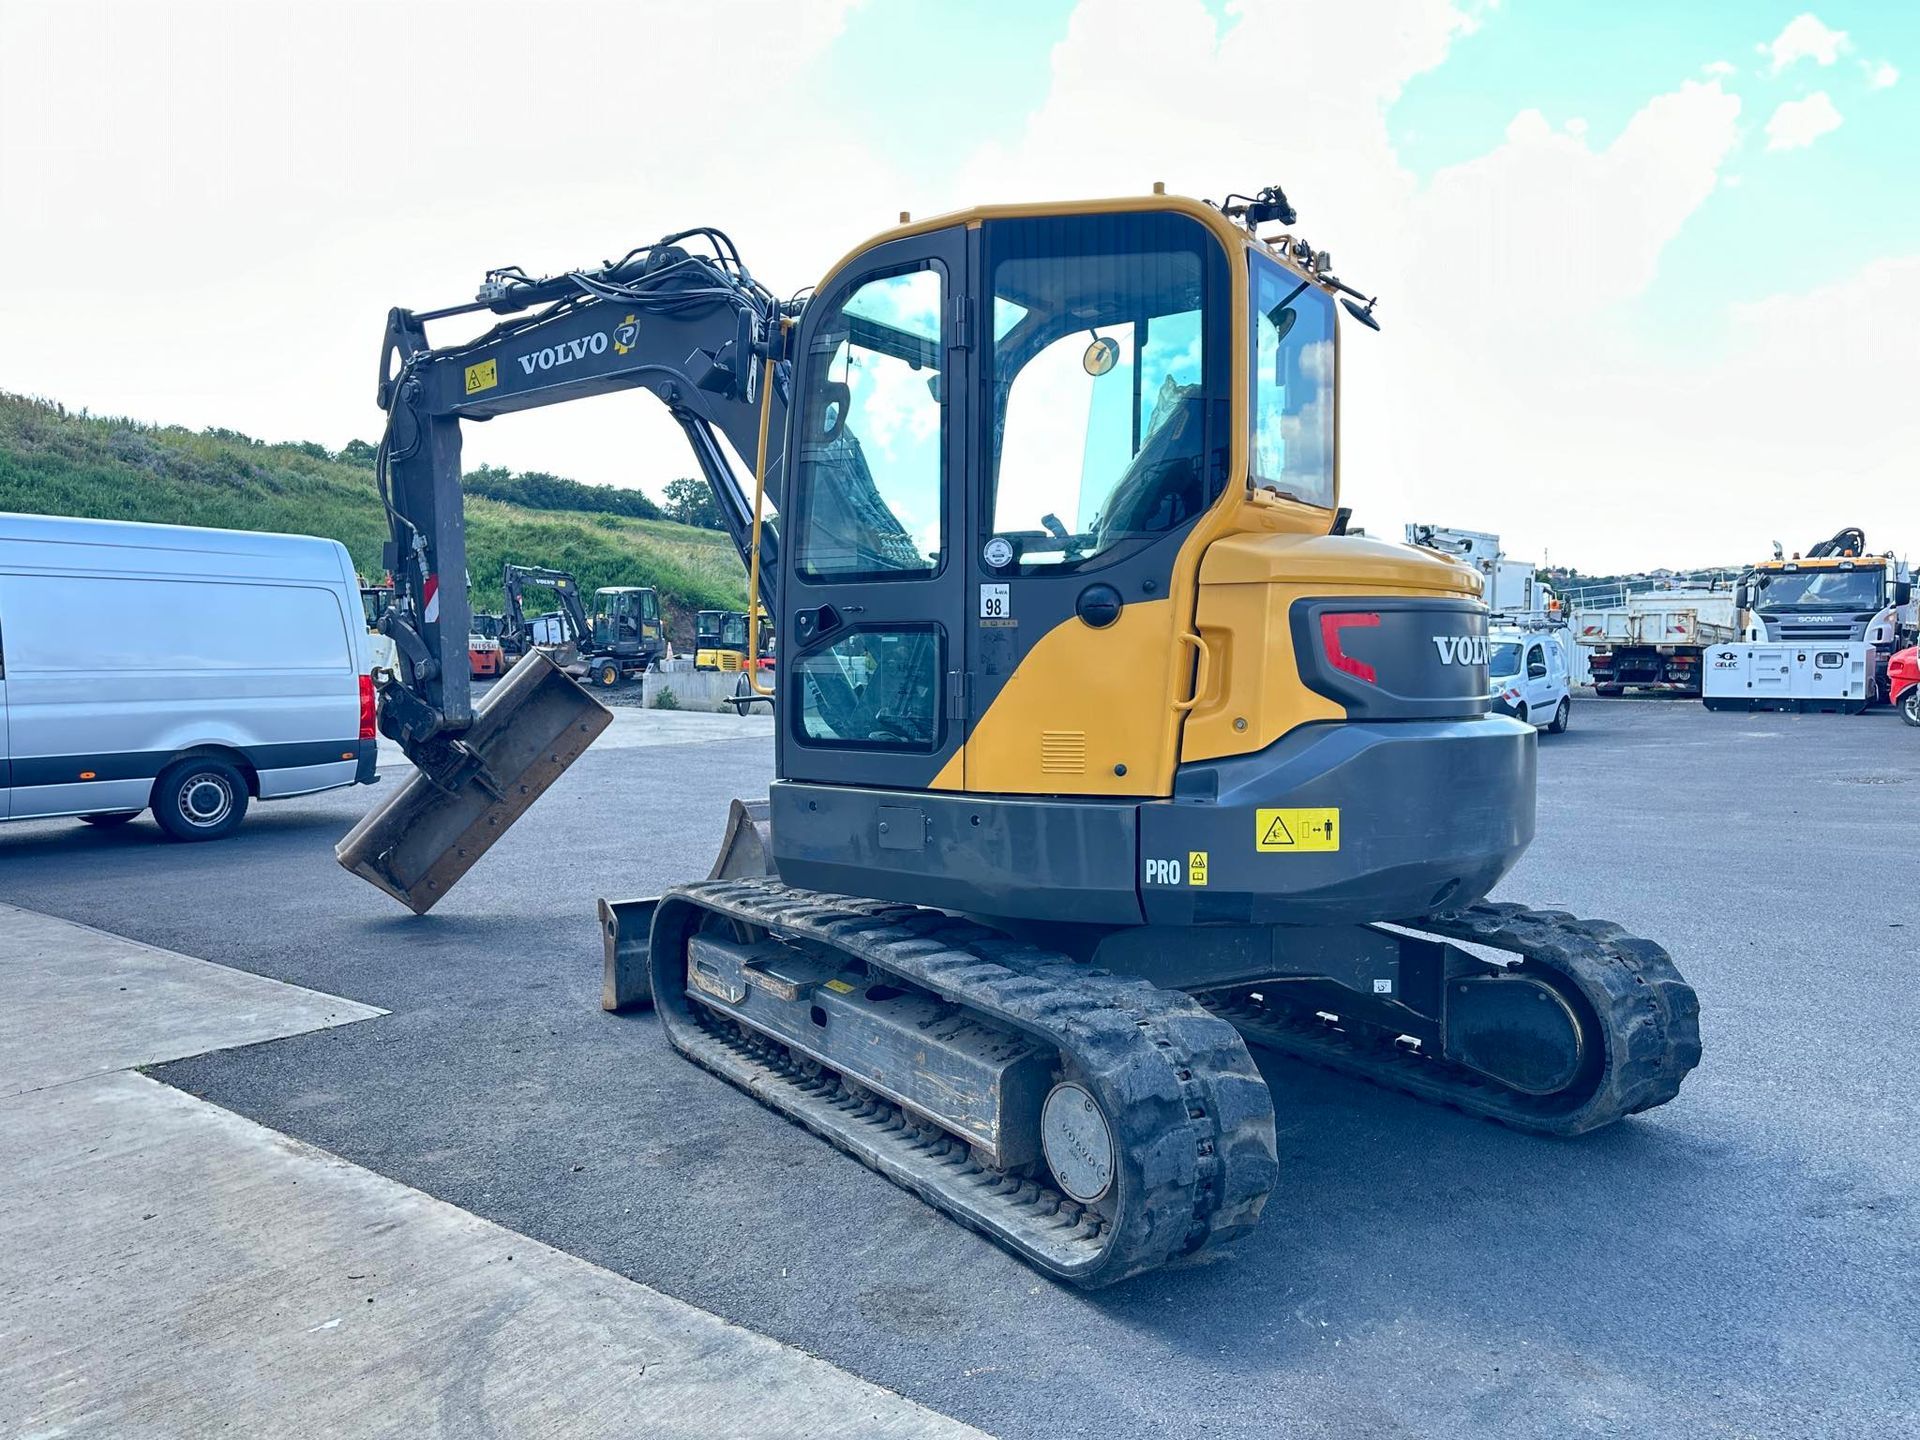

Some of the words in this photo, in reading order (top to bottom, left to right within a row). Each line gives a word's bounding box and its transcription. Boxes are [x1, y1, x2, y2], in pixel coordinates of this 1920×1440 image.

[518, 331, 608, 375] VOLVO
[986, 598, 1002, 616] 98
[1146, 859, 1181, 885] PRO
